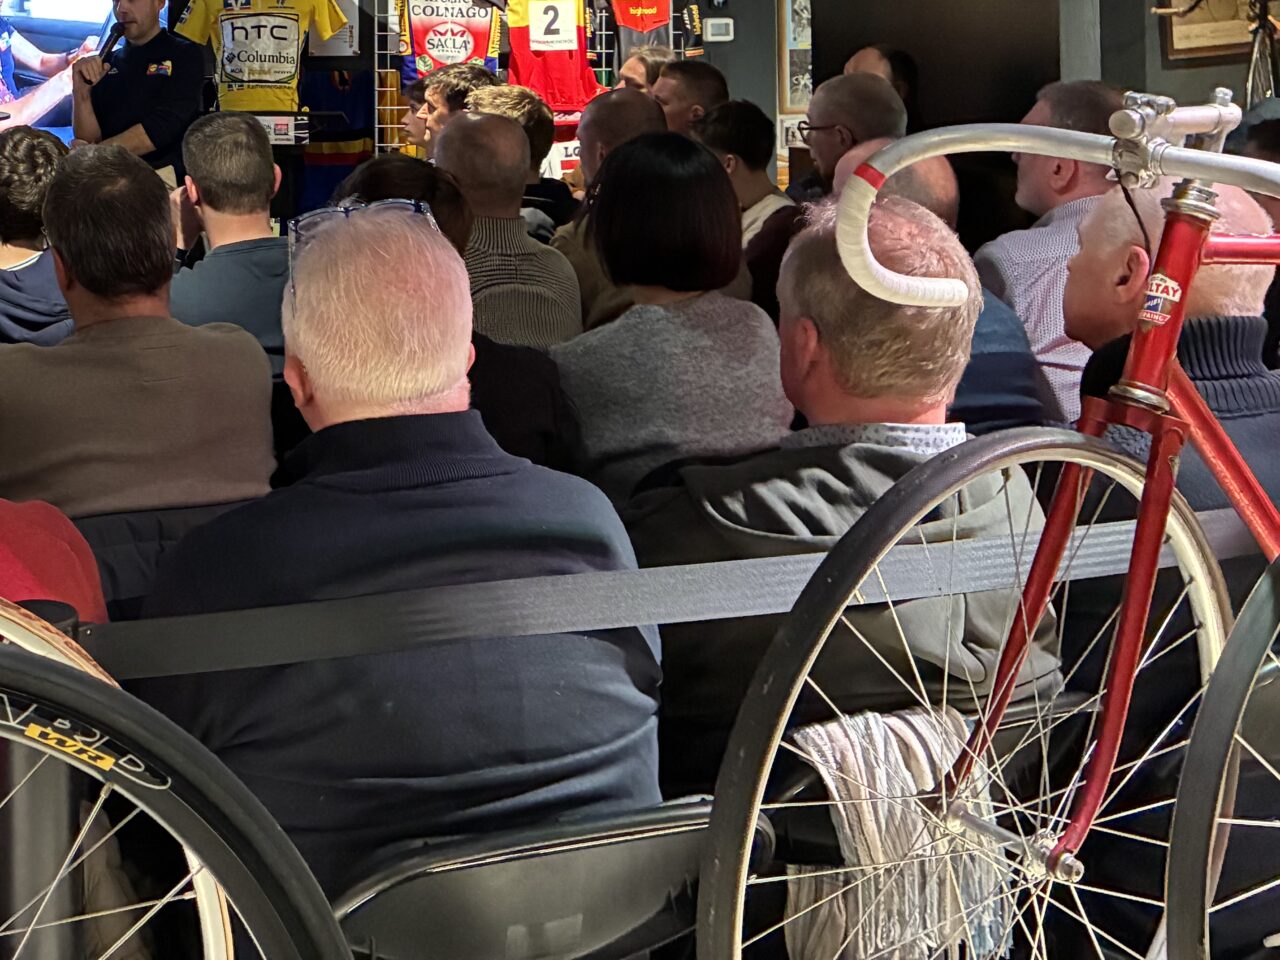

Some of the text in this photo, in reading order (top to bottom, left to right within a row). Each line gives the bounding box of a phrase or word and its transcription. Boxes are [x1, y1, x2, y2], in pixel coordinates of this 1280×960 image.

[411, 4, 489, 19] COLNAGO
[542, 4, 561, 36] 2
[237, 49, 296, 65] Columbia
